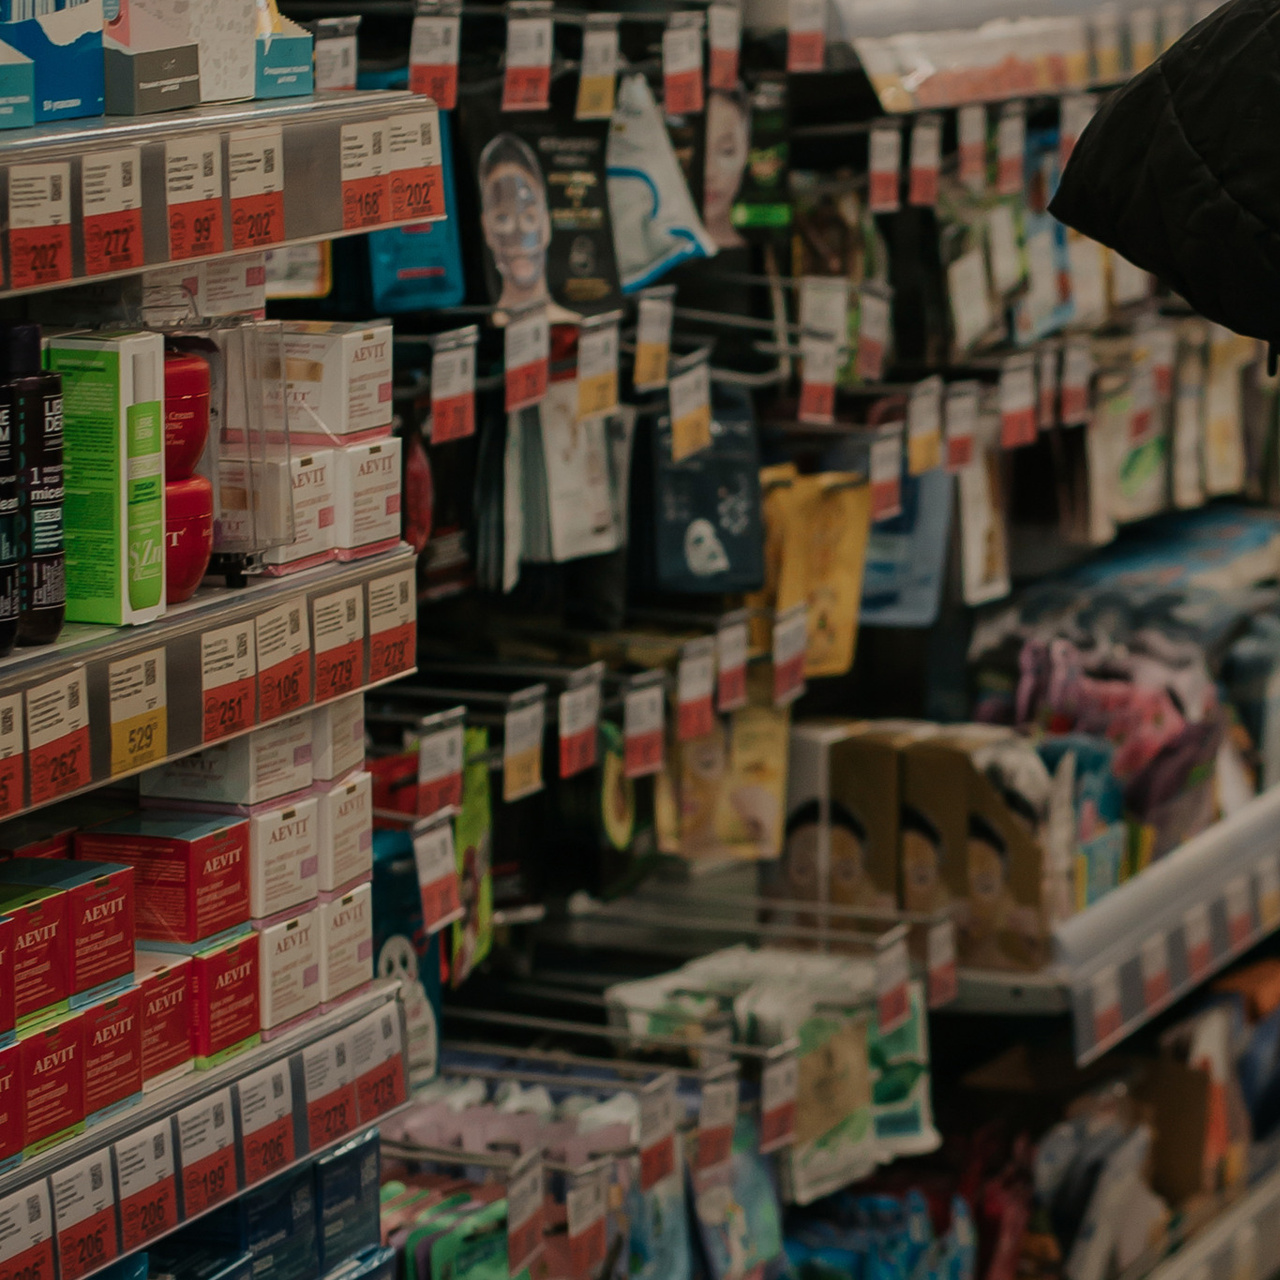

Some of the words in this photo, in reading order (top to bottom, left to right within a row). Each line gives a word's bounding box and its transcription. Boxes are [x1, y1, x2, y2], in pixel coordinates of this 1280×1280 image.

[358, 191, 380, 217] 168
[406, 181, 432, 207] 202
[103, 228, 131, 256] 272
[193, 216, 212, 242] 99
[247, 214, 272, 239] 202
[276, 673, 300, 702] 106
[330, 659, 353, 688] 279
[218, 696, 243, 726] 251
[128, 723, 153, 755] 529
[50, 751, 79, 782] 262
[268, 816, 312, 846] AEVIT
[202, 845, 245, 877] AEVIT
[82, 894, 127, 926] AEVIT
[15, 920, 60, 952] AEVIT
[215, 959, 253, 991] AEVIT
[146, 985, 187, 1018] AEVIT
[92, 1014, 136, 1048] AEVIT
[33, 1042, 78, 1076] AEVIT
[201, 1165, 227, 1196] 199
[140, 1200, 166, 1232] 206
[76, 1232, 105, 1265] 206
